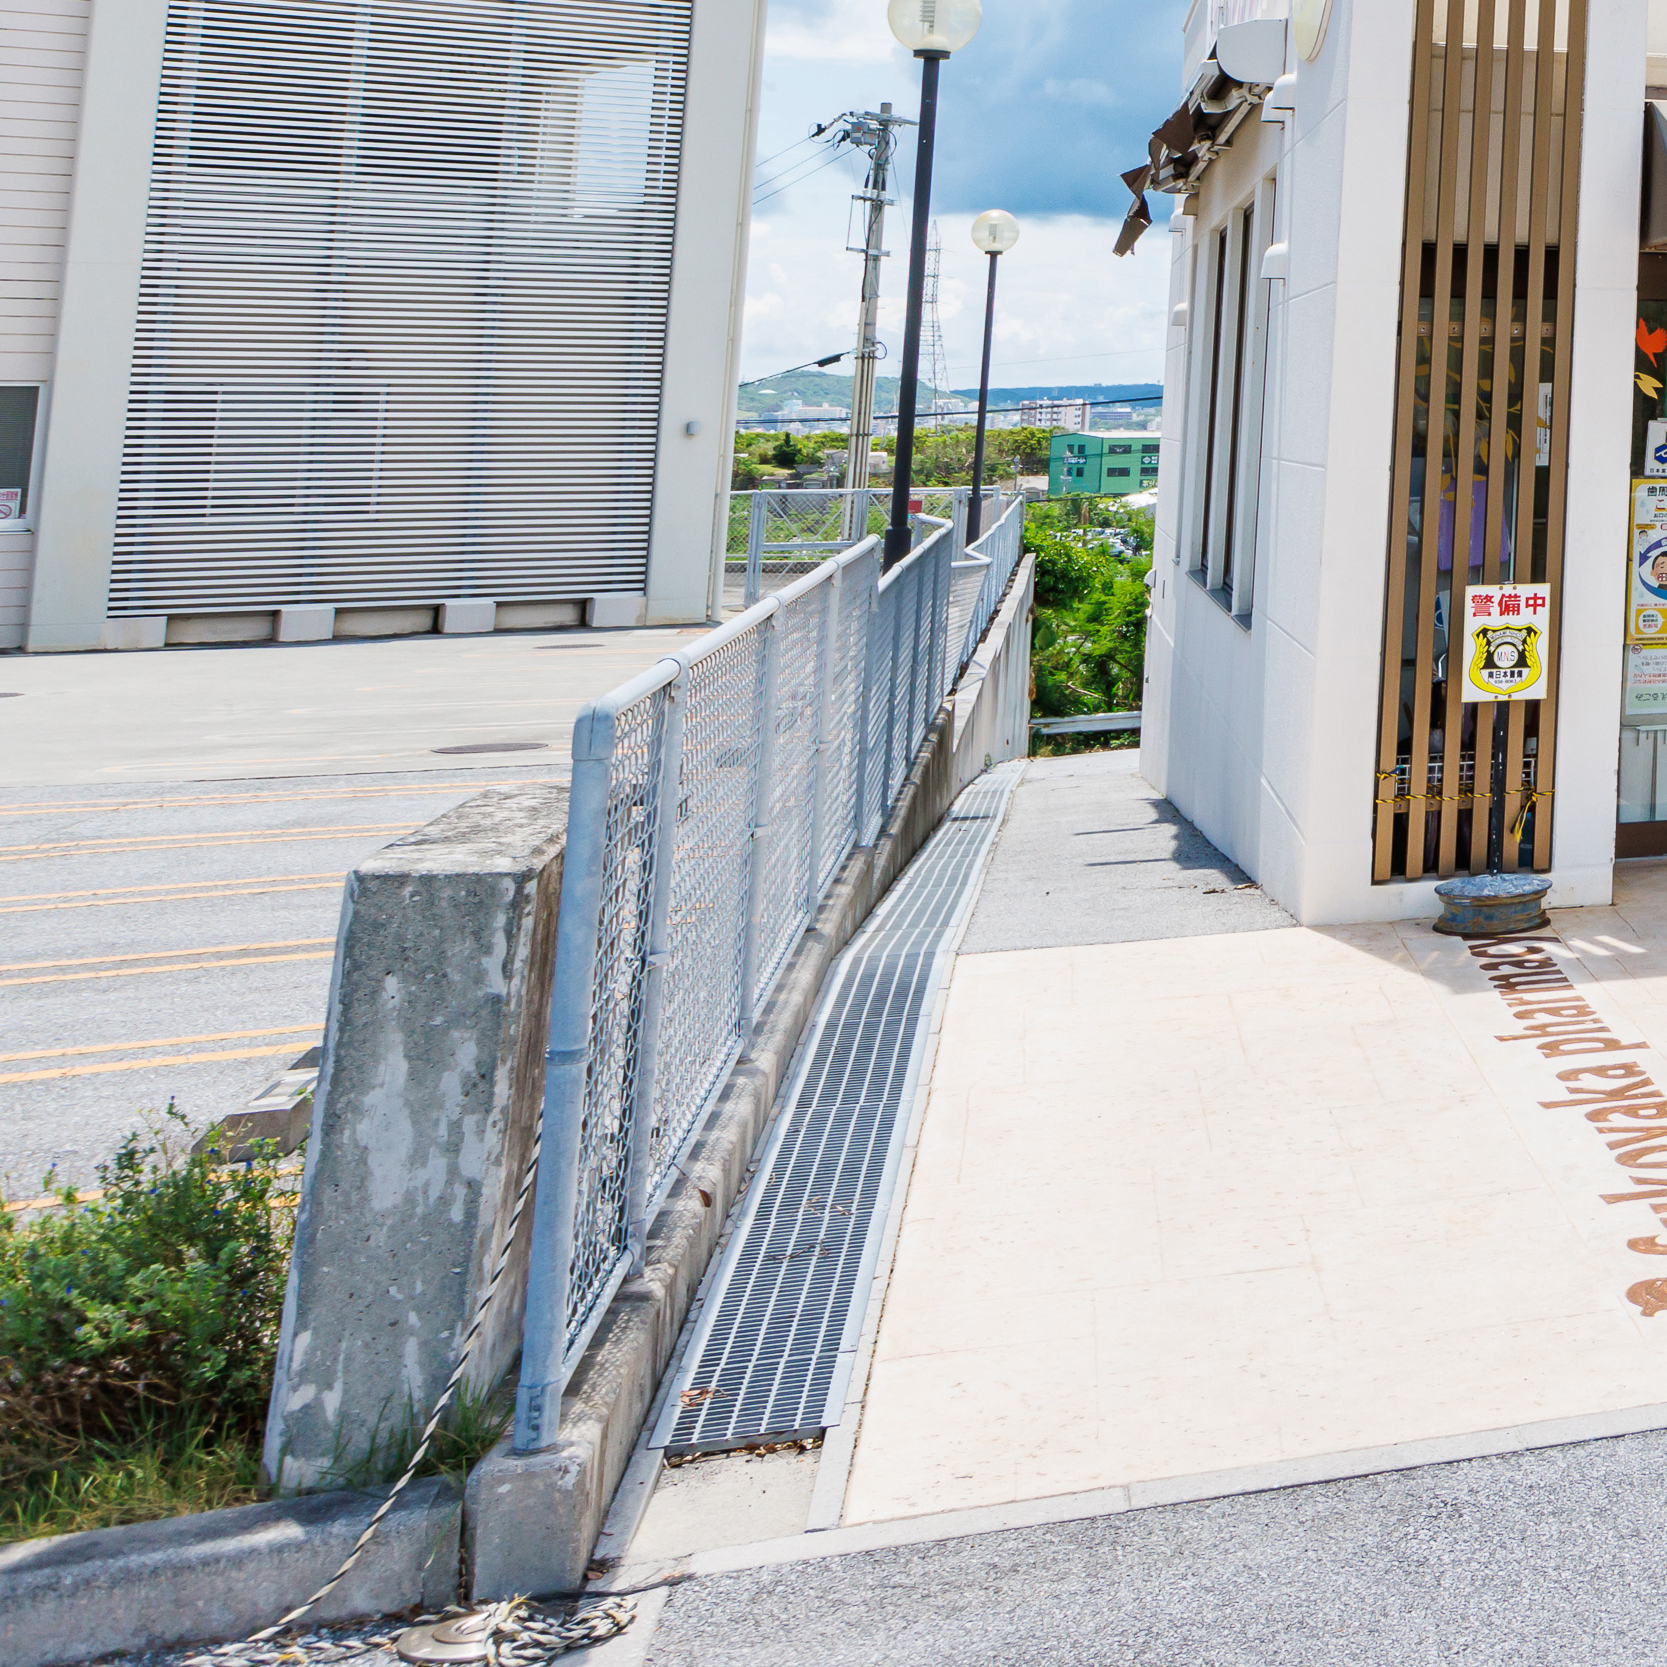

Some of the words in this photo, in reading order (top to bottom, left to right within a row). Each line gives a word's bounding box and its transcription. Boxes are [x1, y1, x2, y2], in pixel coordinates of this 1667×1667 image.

[1471, 593, 1546, 617] 警備中
[1488, 670, 1523, 679] 南日本警備
[1461, 935, 1651, 1058] pharmacy
